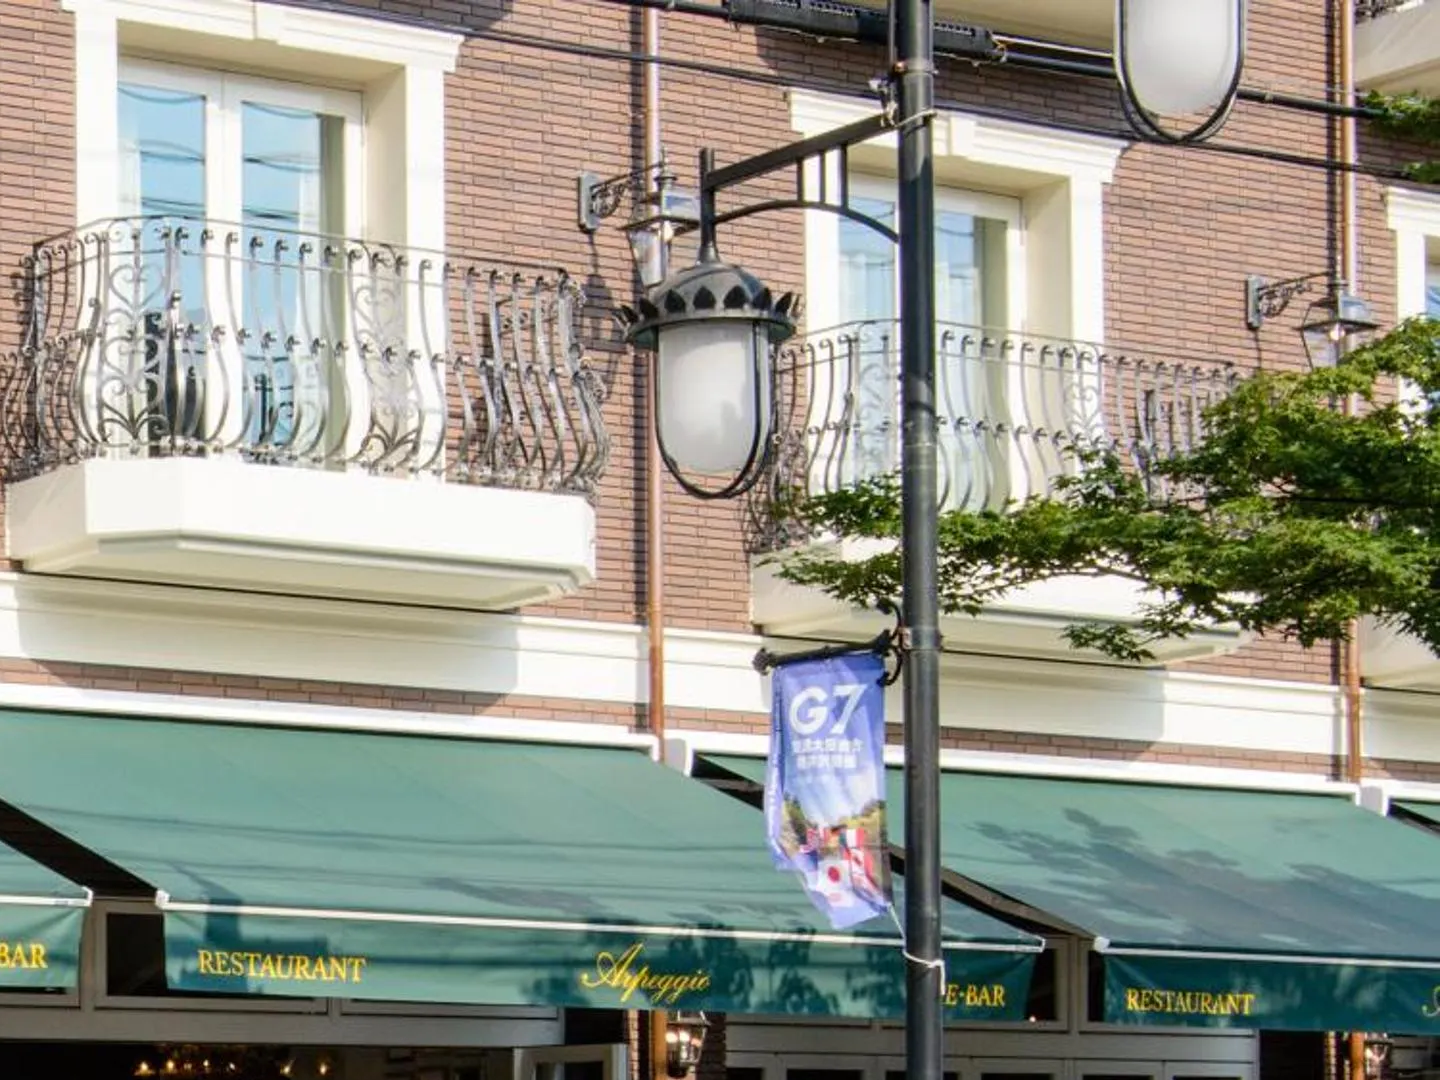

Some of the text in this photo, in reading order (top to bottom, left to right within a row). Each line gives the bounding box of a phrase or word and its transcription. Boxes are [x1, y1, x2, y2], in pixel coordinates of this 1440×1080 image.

[791, 685, 867, 734] G7
[198, 943, 1005, 1007] RESTAURANT Arpeggio E·BAR
[1126, 989, 1255, 1015] RESTAURANT
